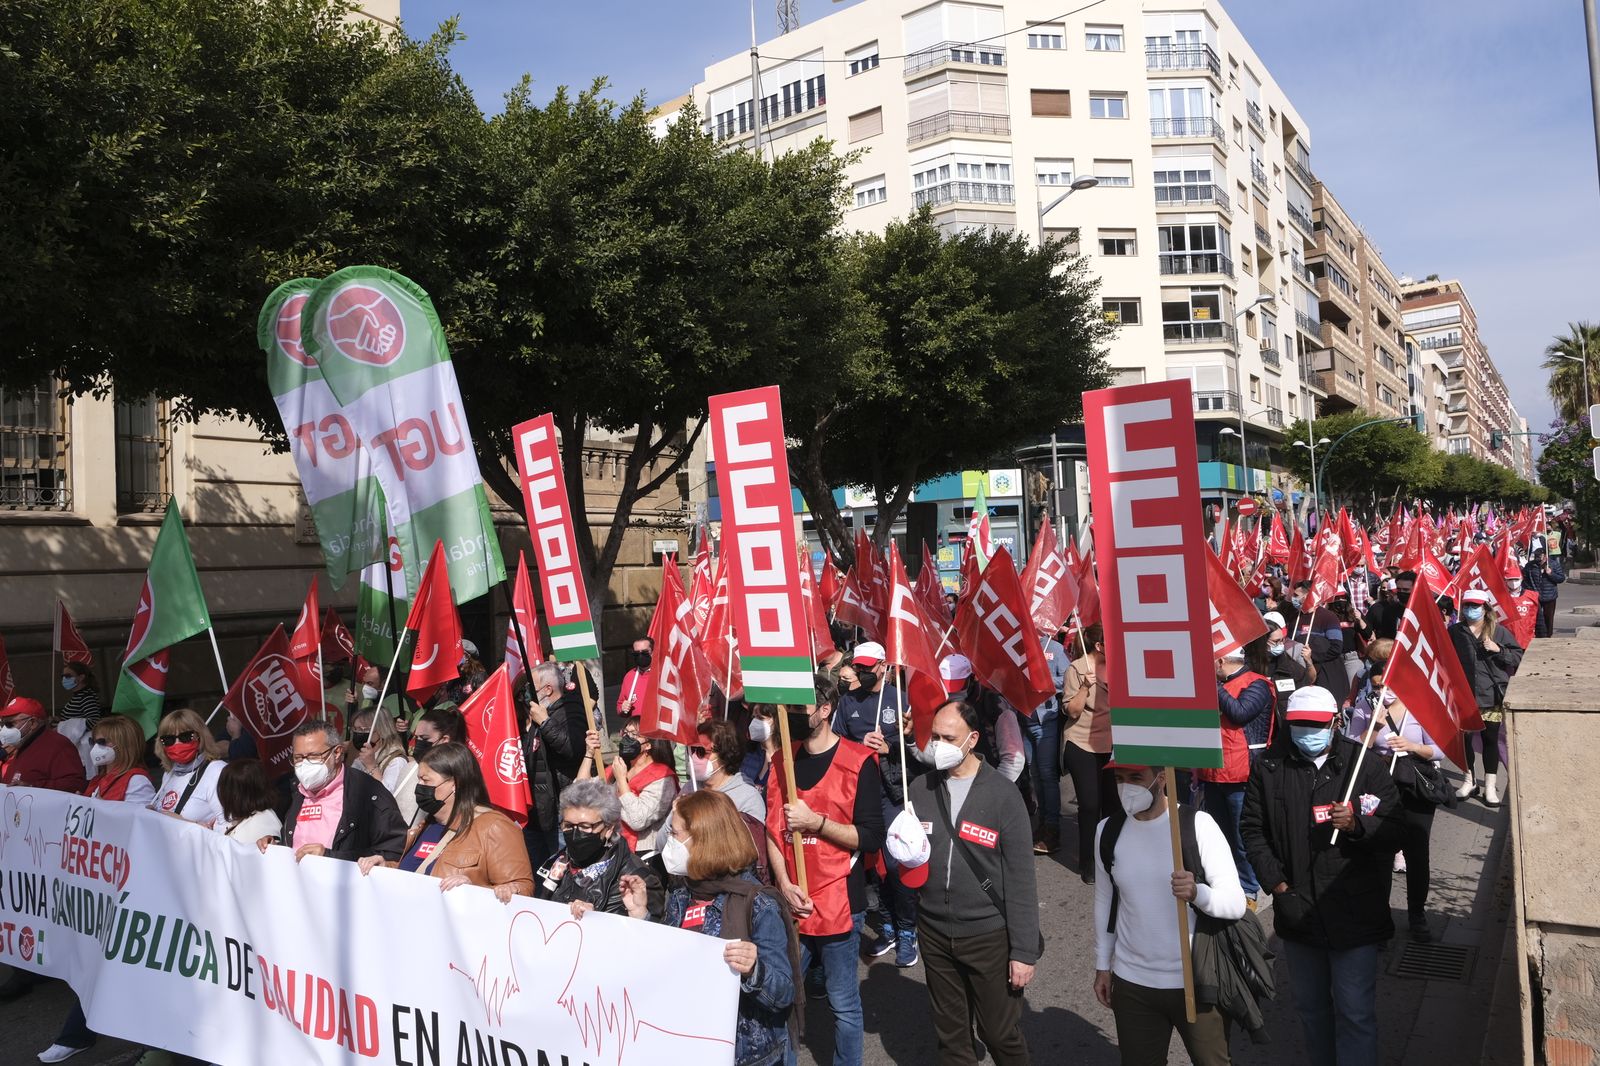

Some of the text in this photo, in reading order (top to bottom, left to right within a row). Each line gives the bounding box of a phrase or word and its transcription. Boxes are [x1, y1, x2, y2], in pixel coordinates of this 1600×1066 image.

[520, 426, 582, 618] CCOO
[721, 402, 795, 648] CCOO
[1103, 398, 1196, 698] CCOO
[258, 659, 306, 726] UGT
[300, 805, 322, 816] CCOO
[498, 742, 519, 777] UGT
[961, 823, 997, 842] CCOO
[9, 870, 48, 919] UNA
[52, 877, 107, 943] SANIDA
[225, 936, 255, 1000] DE
[257, 954, 380, 1058] CALIDAD
[392, 1003, 441, 1066] EN
